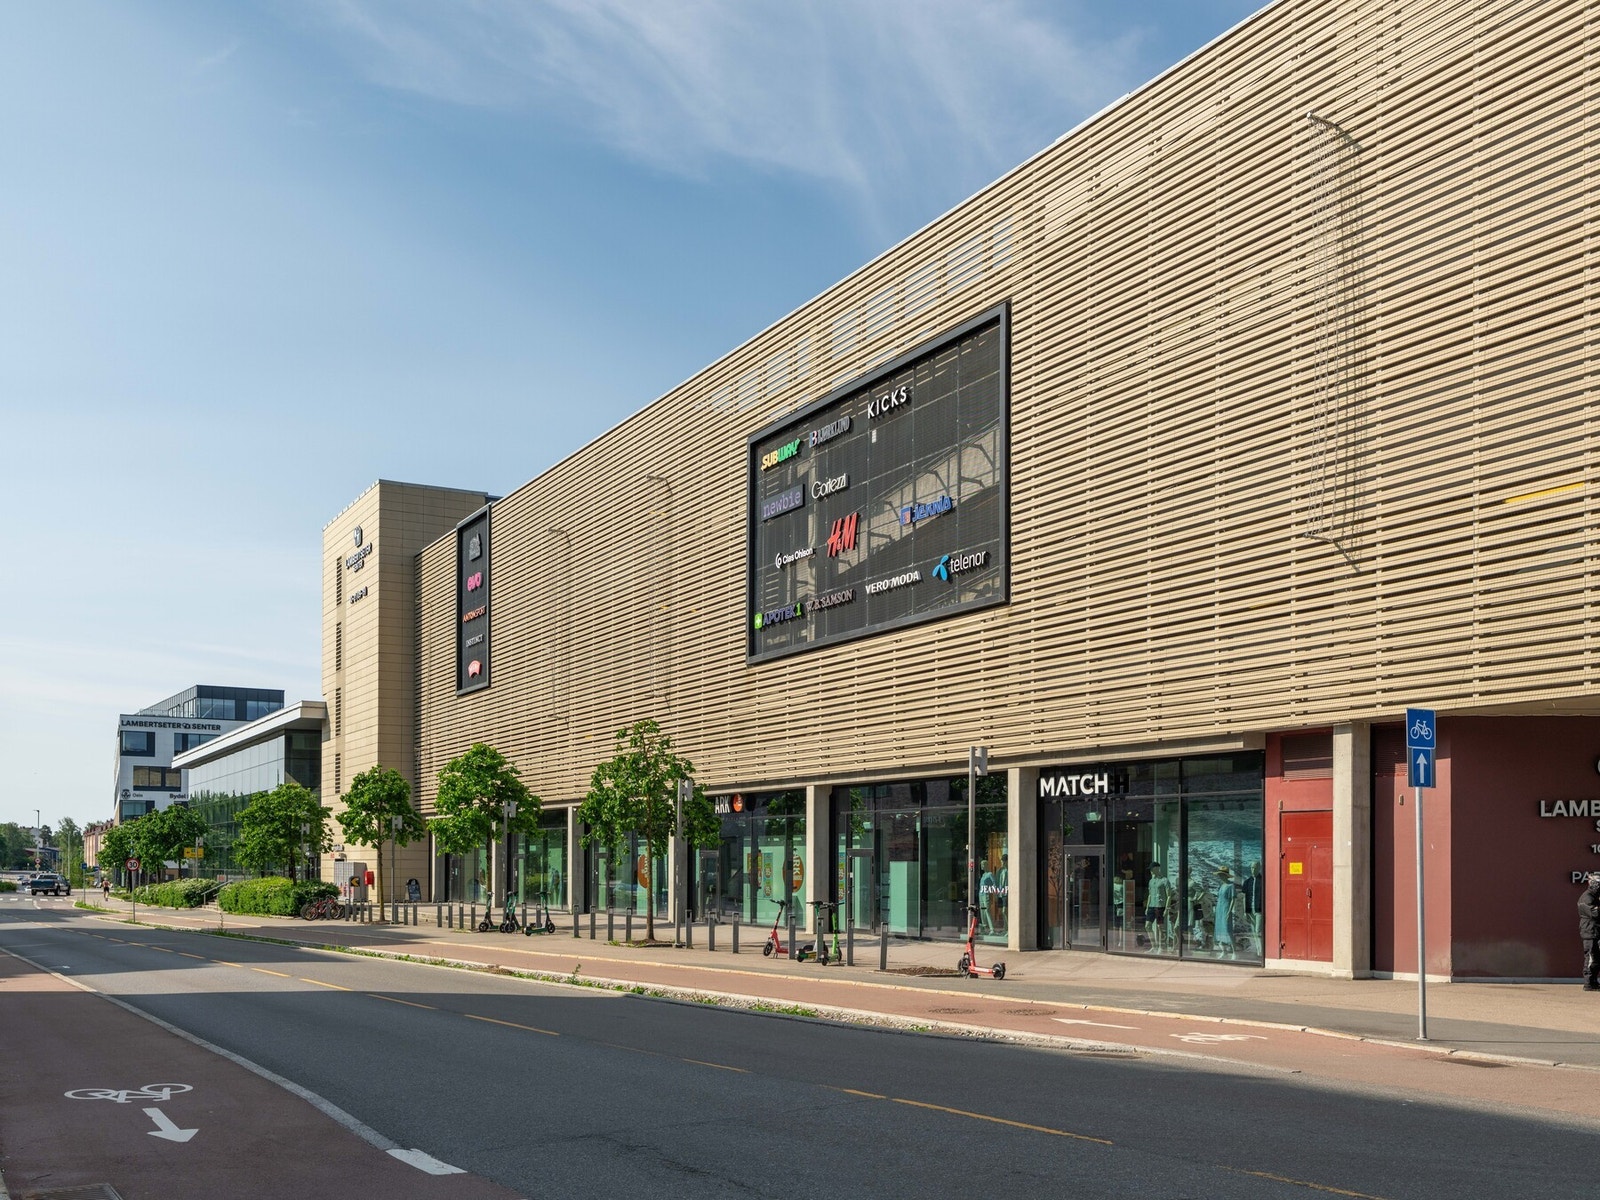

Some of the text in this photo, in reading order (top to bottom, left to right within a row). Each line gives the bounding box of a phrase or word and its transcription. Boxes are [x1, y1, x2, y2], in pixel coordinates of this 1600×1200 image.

[867, 386, 908, 419] KICKS
[761, 438, 800, 470] SUBWAY
[763, 490, 801, 518] newbie
[827, 512, 859, 557] H&M
[782, 547, 813, 565] Clas Ohlson
[950, 551, 987, 573] telenor
[865, 570, 920, 594] VERO MODA
[821, 589, 854, 609] SAMSON
[763, 603, 796, 626] APOTEK
[121, 719, 221, 731] LAMBERTSETER SENTER
[1040, 773, 1109, 797] MATCH
[715, 796, 730, 814] ARK
[980, 885, 996, 893] JEAN
